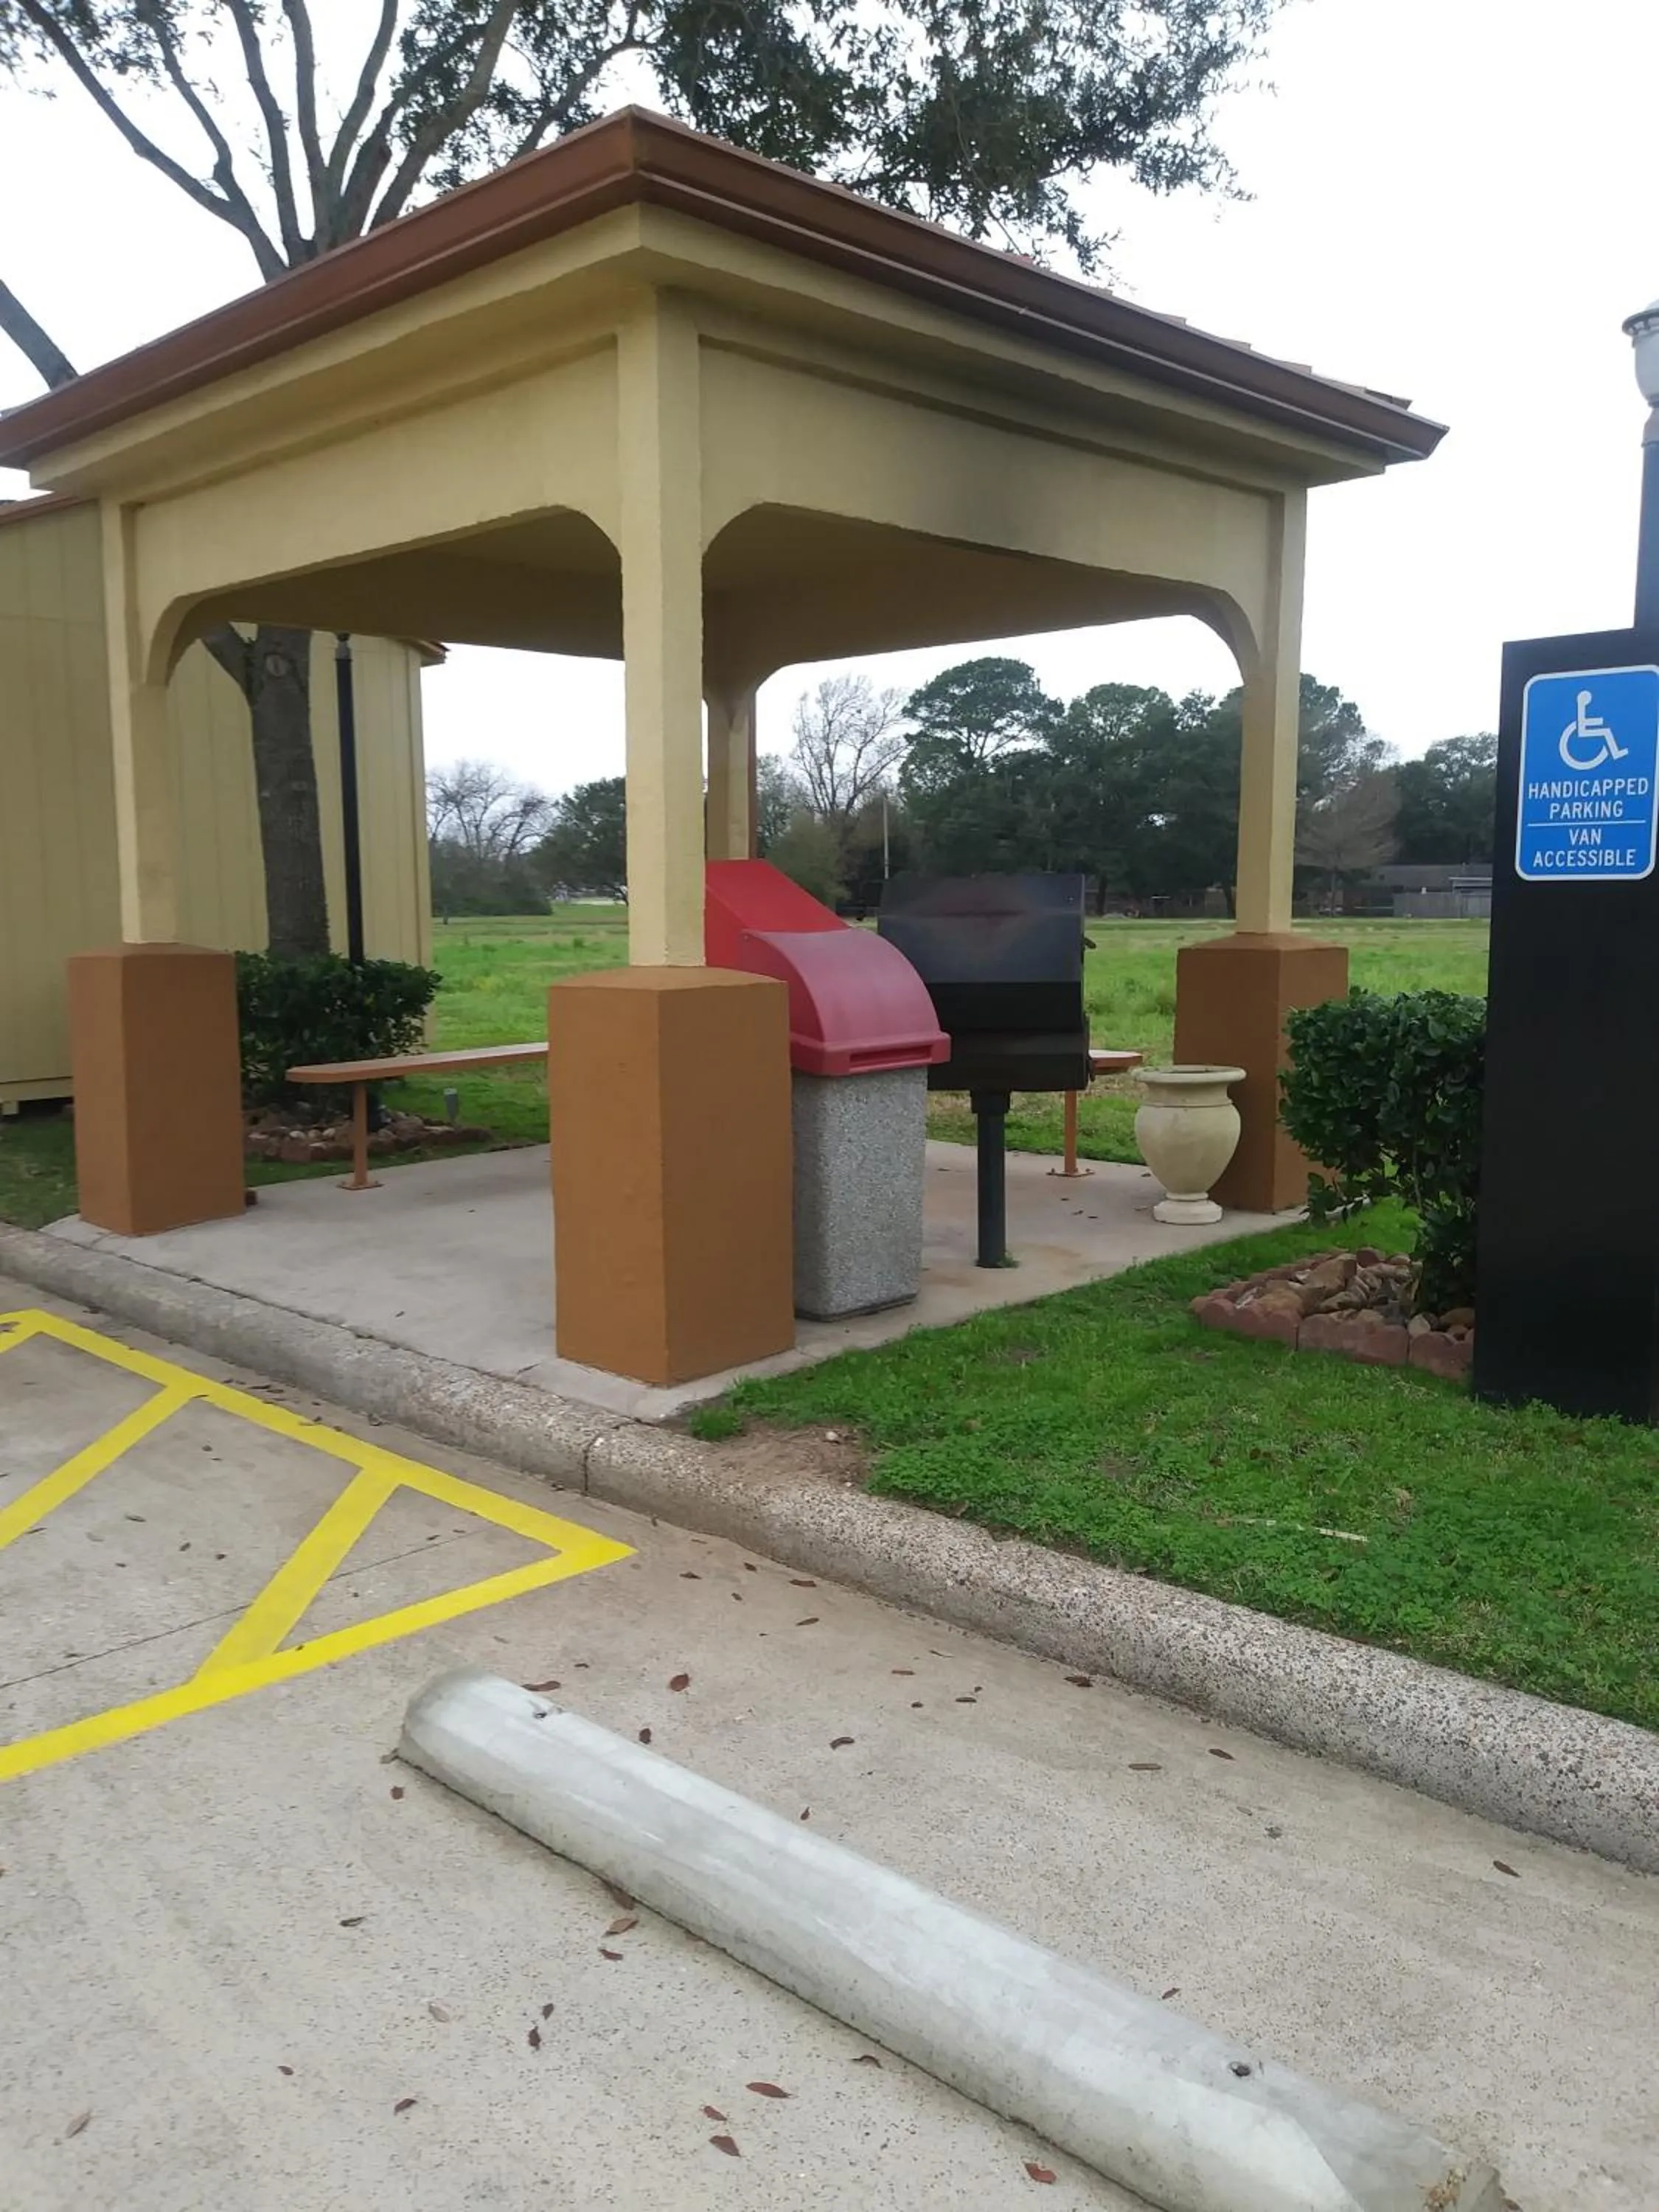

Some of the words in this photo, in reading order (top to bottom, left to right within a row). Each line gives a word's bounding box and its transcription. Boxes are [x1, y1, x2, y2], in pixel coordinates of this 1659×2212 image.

[1528, 778, 1649, 799] HANDICAPPED
[1550, 801, 1623, 818] PARKING
[1569, 828, 1602, 845] VAN
[1532, 849, 1636, 866] ACCESSIBLE
